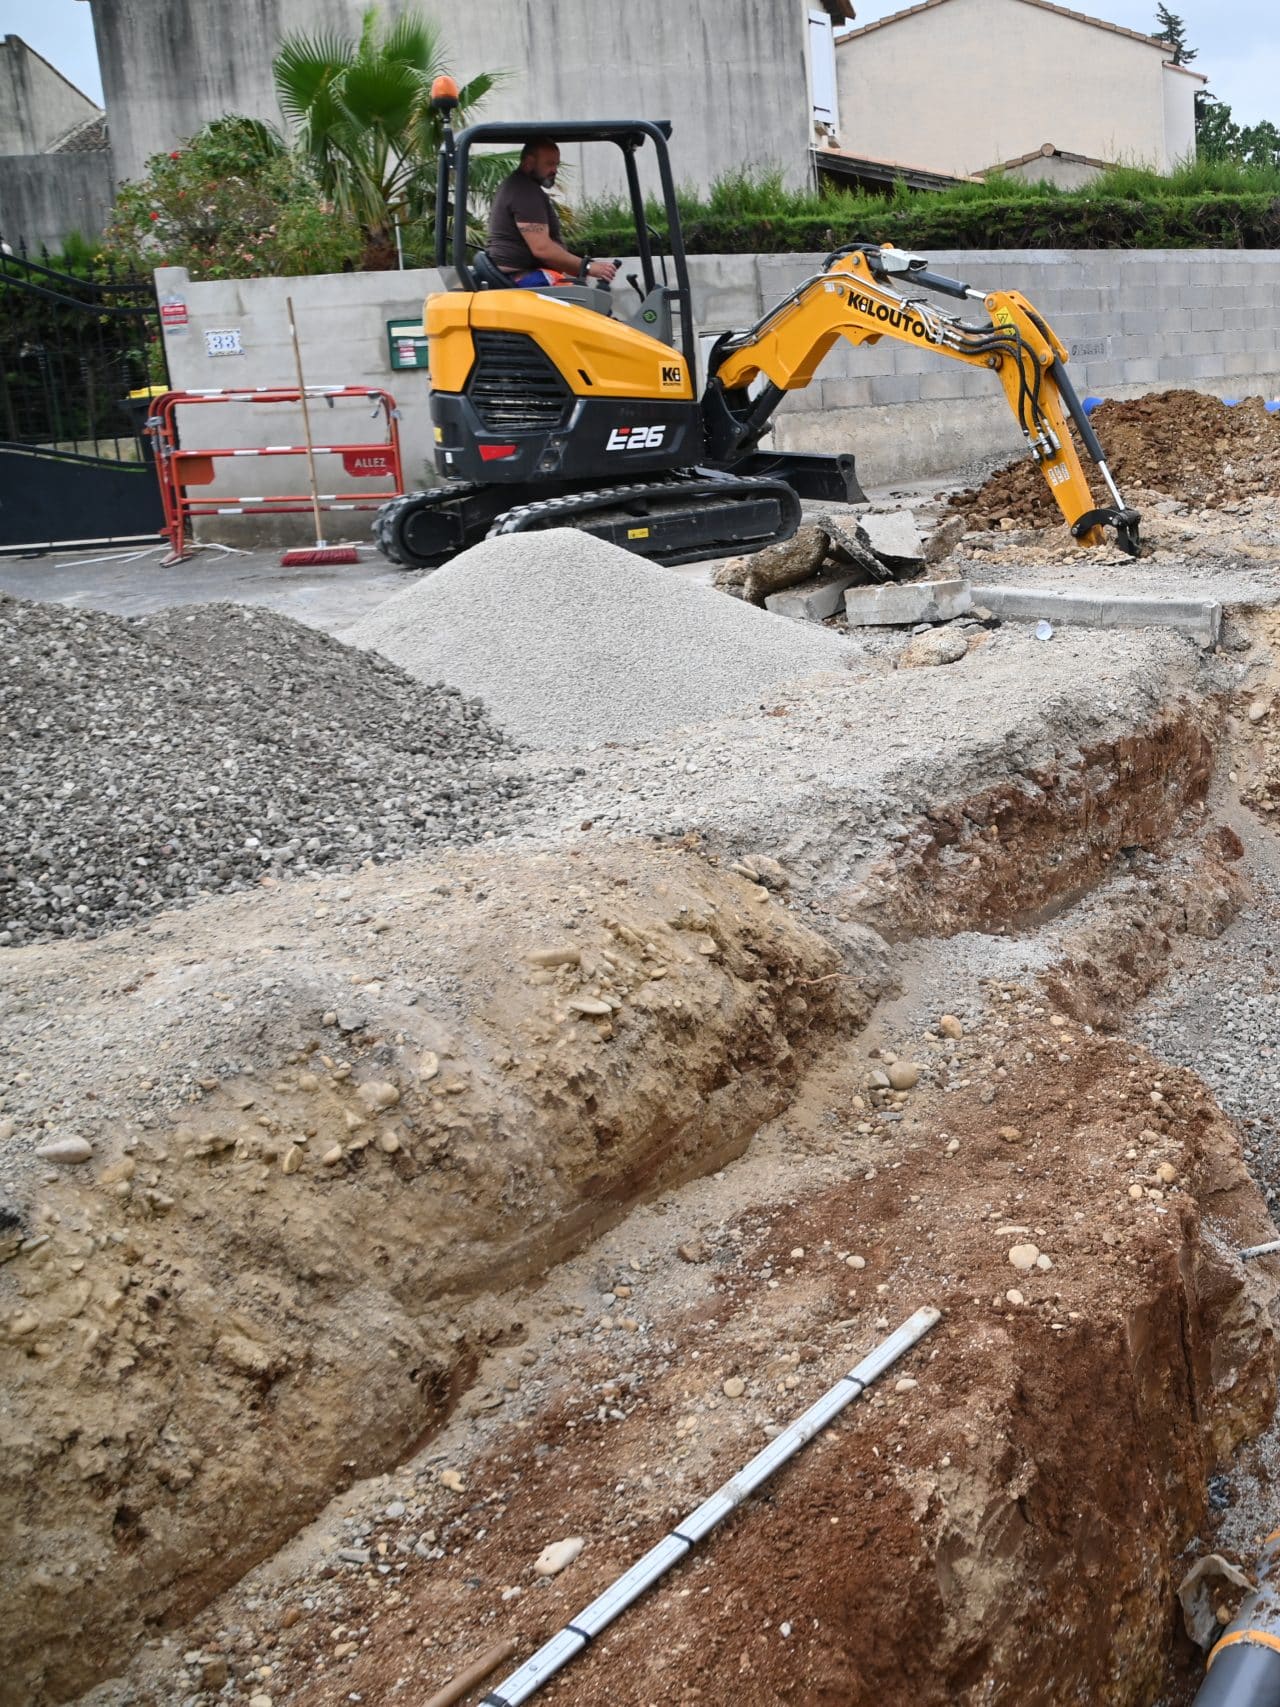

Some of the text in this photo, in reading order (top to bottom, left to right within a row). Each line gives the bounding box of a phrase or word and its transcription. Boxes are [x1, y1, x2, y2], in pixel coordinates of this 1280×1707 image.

[213, 335, 235, 349] 33
[605, 425, 667, 451] E26
[354, 457, 386, 469] ALLEZ
